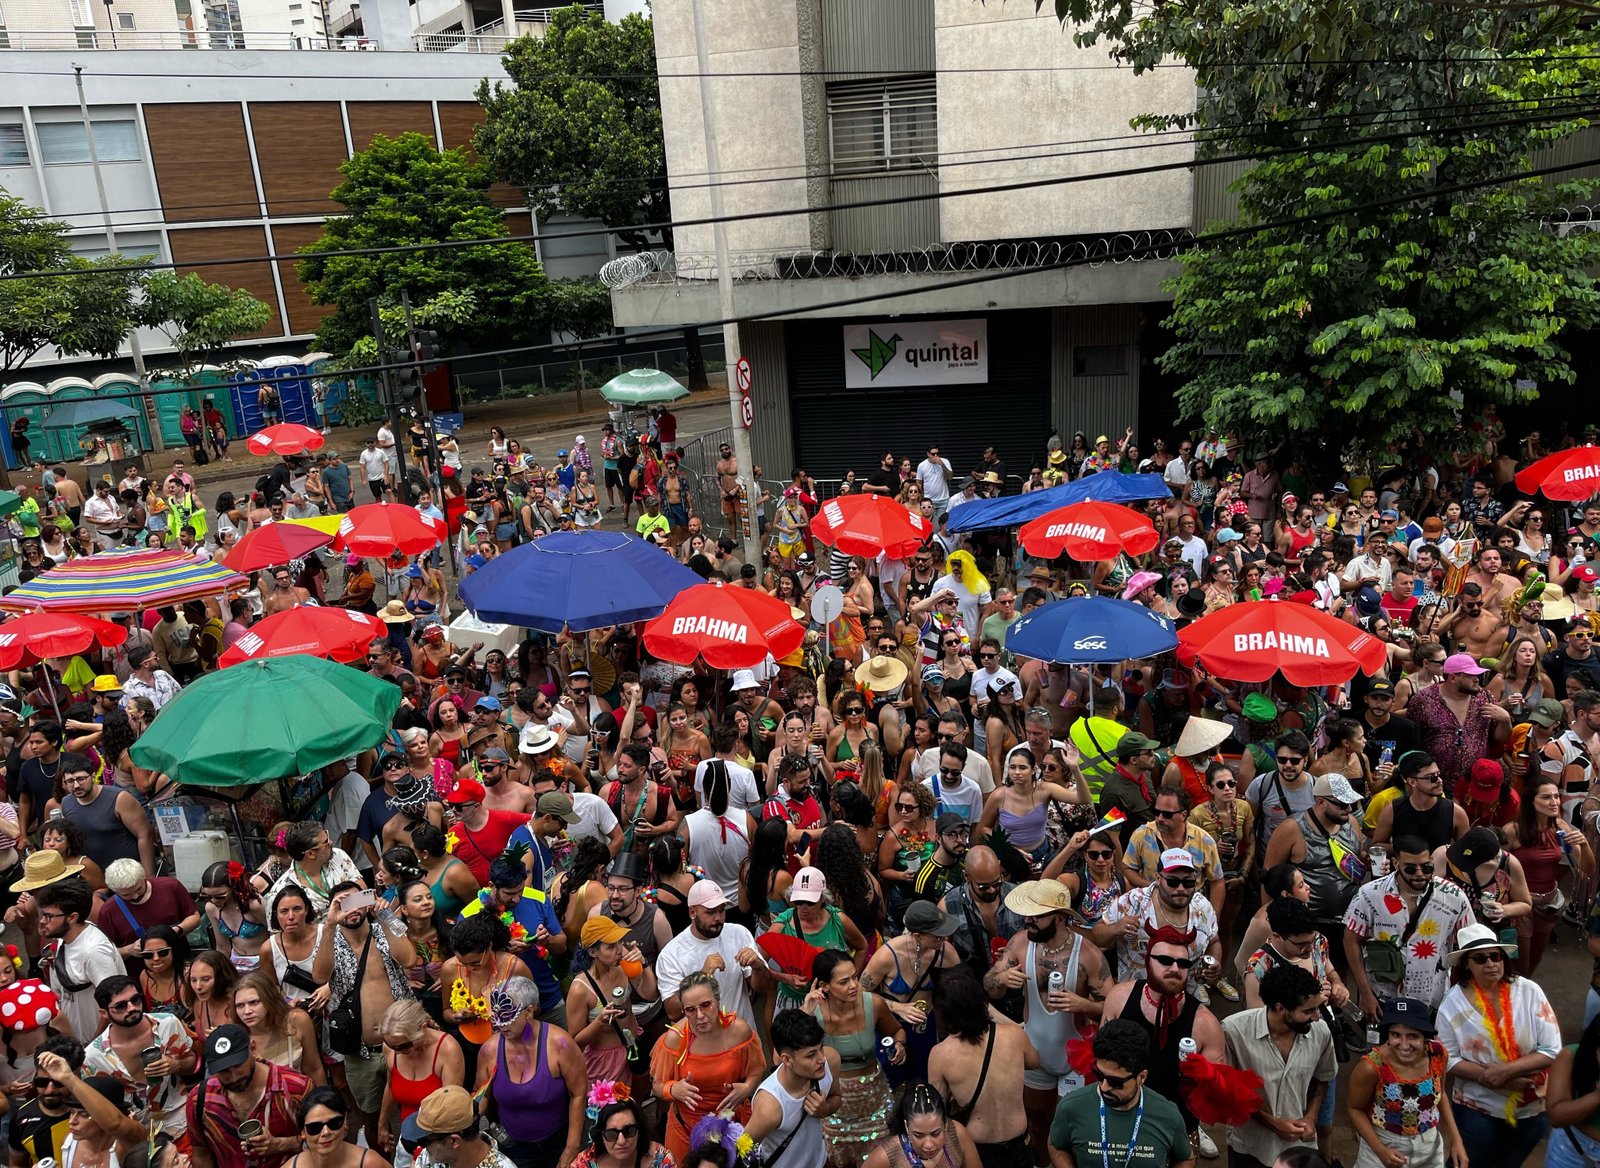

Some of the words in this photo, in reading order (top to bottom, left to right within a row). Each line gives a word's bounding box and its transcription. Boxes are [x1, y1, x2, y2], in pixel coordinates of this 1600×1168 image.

[905, 340, 978, 368] quintal
[1045, 522, 1106, 543] BRAHMA
[672, 616, 747, 644] BRAHMA
[1233, 630, 1330, 658] BRAHMA
